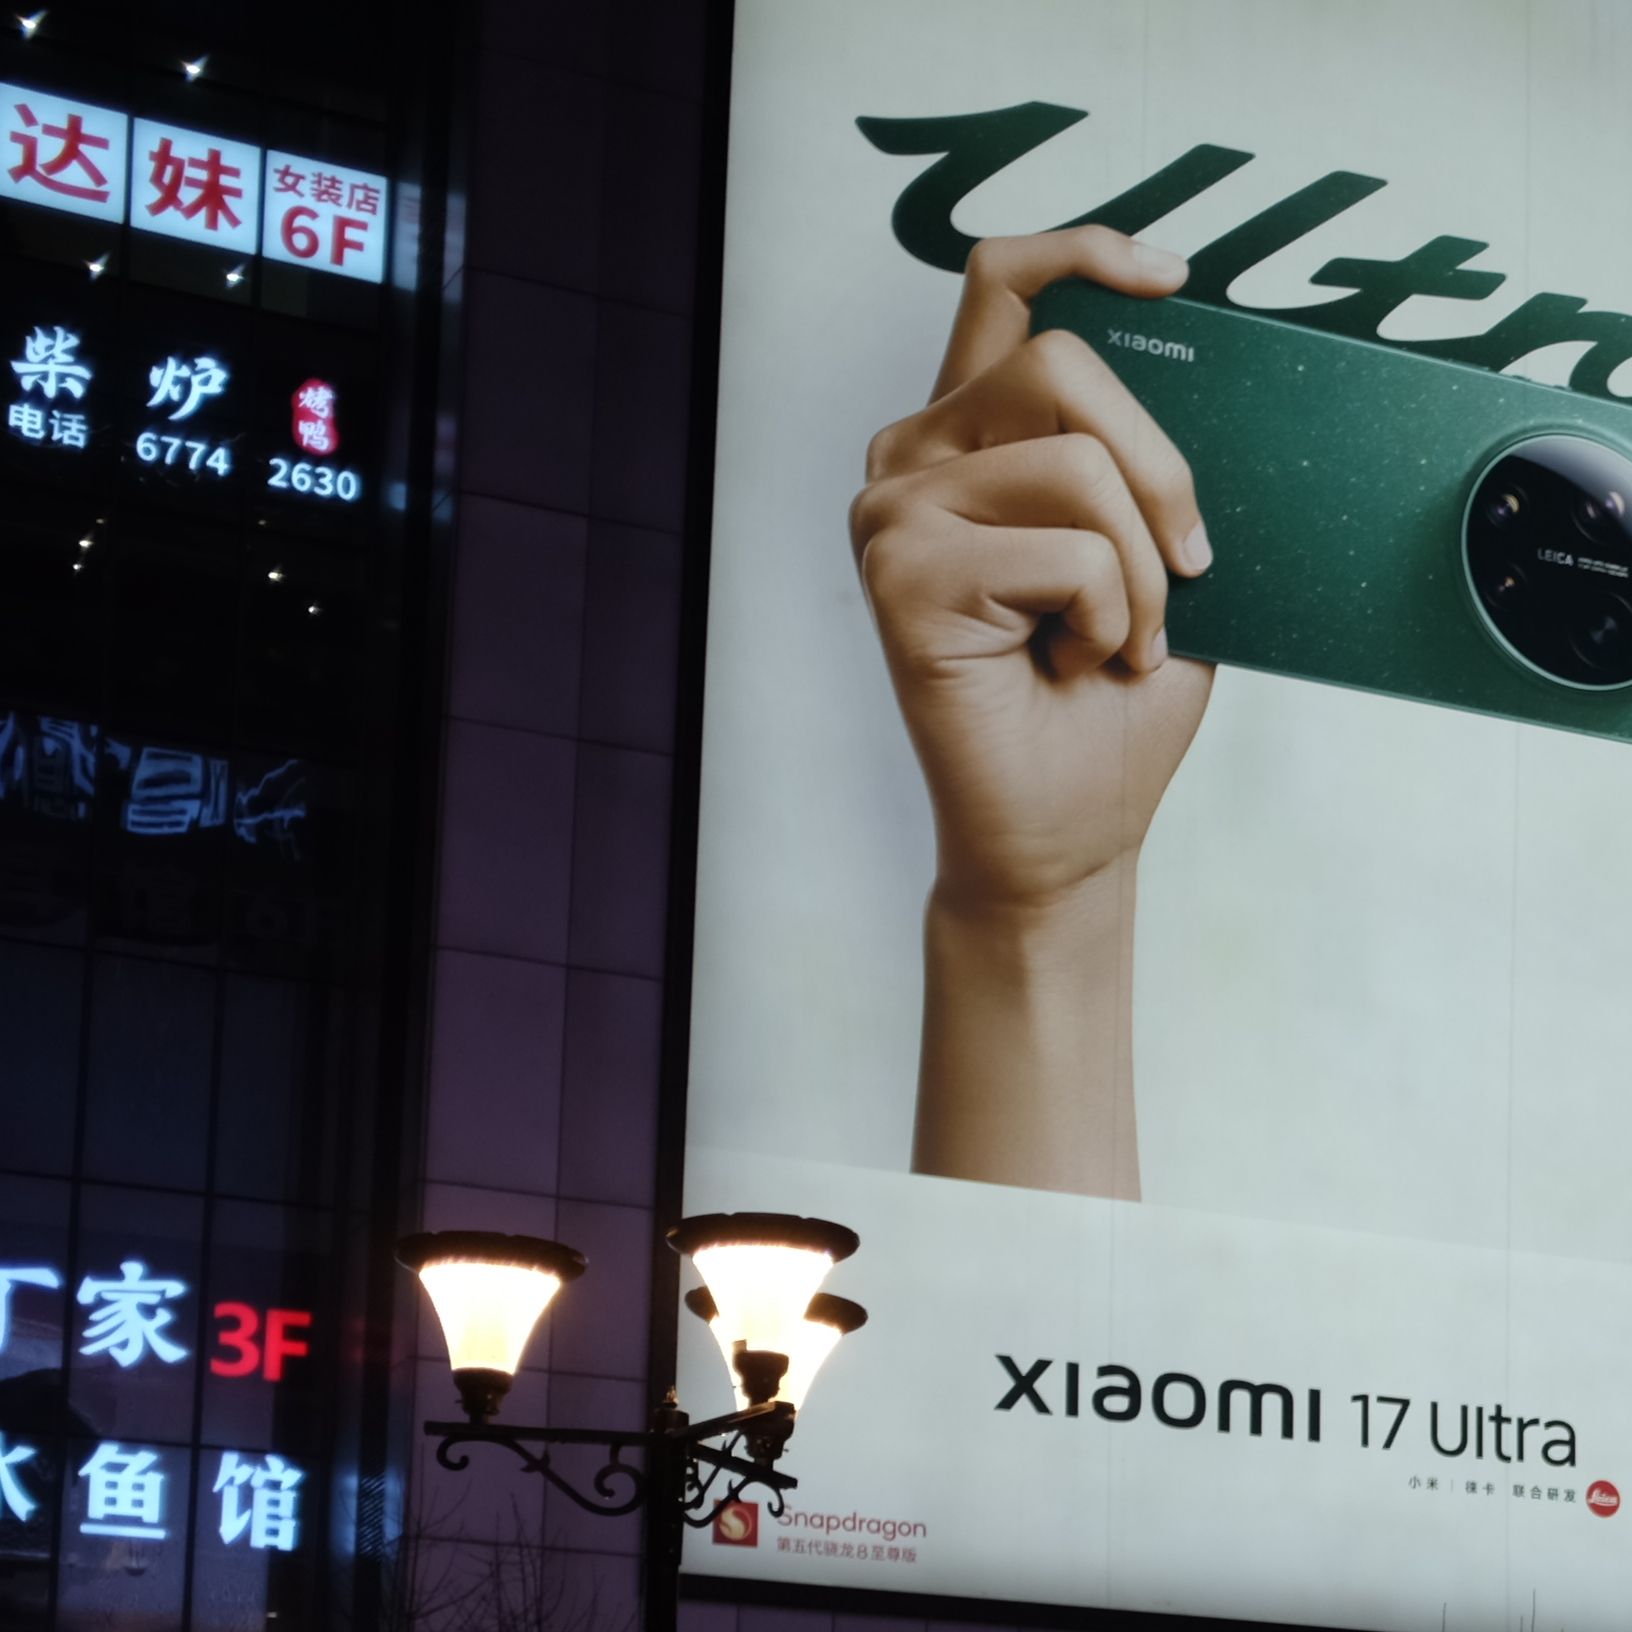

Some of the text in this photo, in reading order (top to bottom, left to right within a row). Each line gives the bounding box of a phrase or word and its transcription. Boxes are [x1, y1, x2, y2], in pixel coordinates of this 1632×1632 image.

[7, 102, 243, 232] 达妹
[273, 163, 381, 216] 女装店
[279, 205, 369, 267] 6F
[10, 325, 229, 421] 柴炉
[7, 404, 358, 502] 电话 6774 2630
[210, 1301, 312, 1382] 3F
[1350, 1394, 1411, 1450] 17
[1429, 1400, 1577, 1467] Ultra
[1408, 1474, 1440, 1491] 小米
[777, 1504, 927, 1541] Snapdragon
